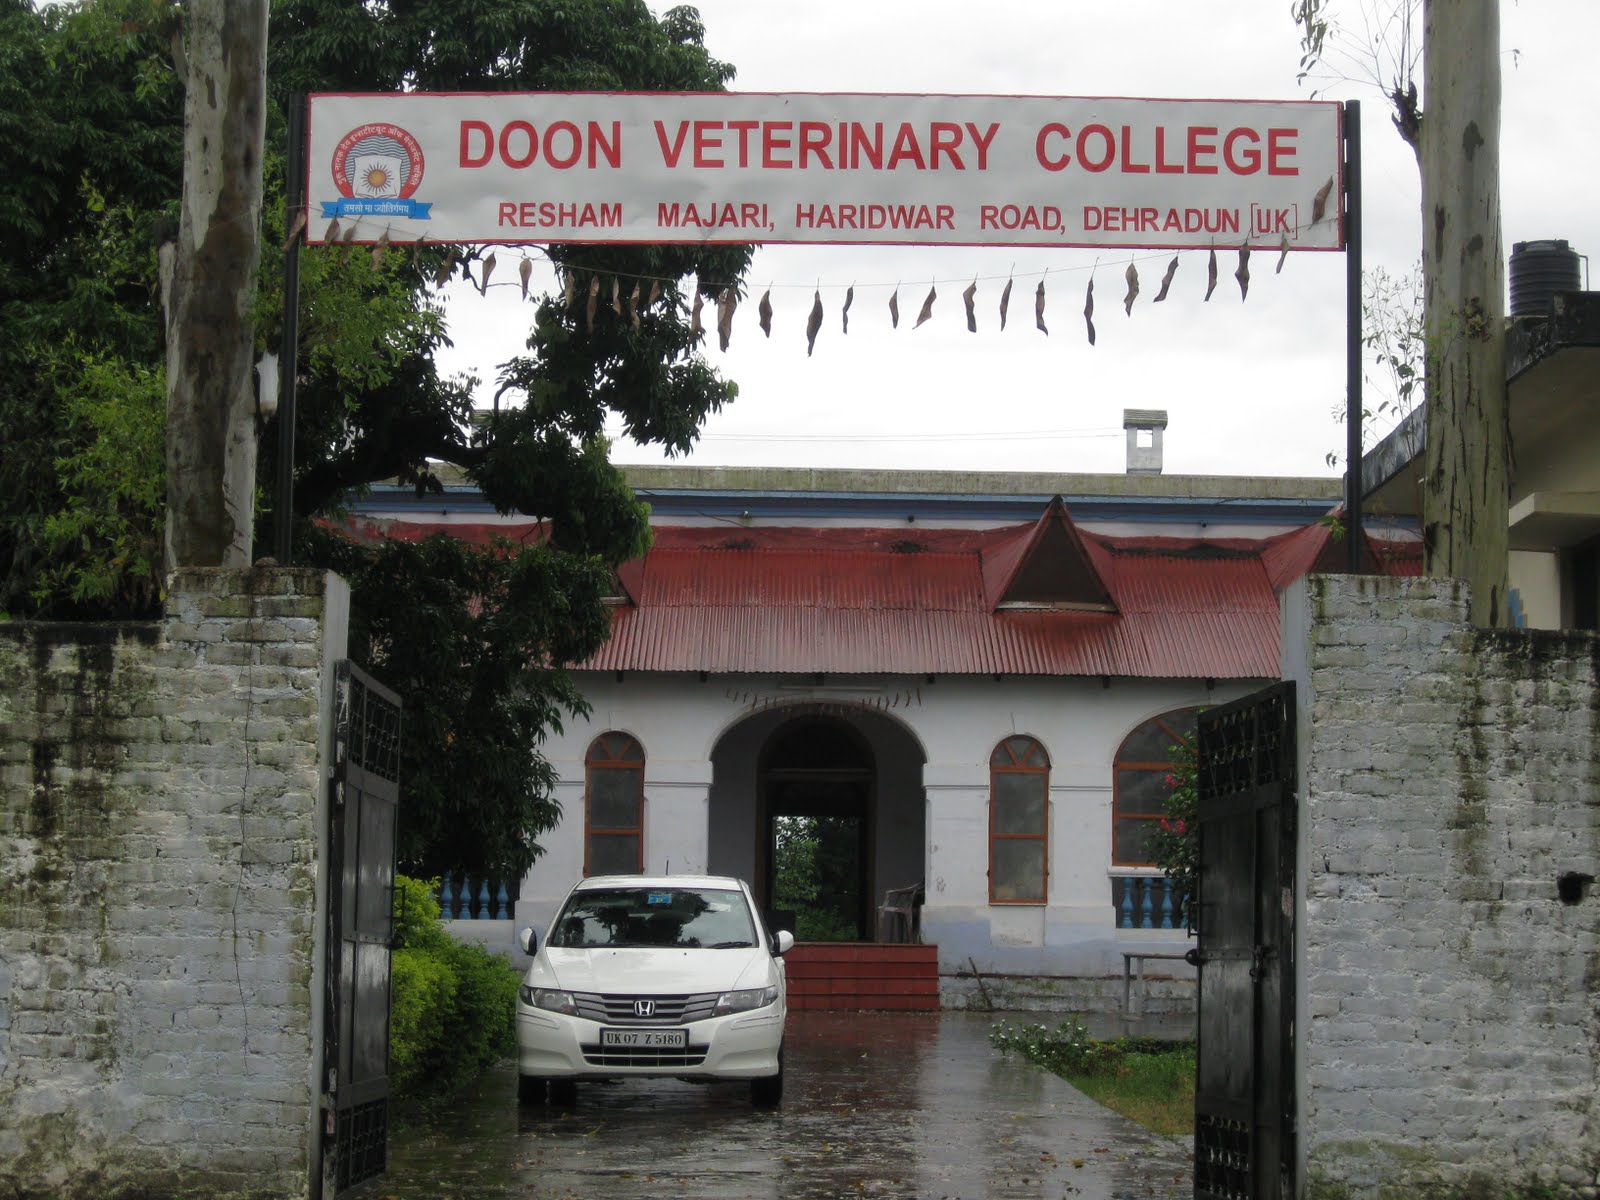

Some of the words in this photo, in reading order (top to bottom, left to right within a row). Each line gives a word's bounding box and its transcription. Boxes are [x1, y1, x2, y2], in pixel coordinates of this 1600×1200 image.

[334, 150, 344, 170] नानक
[340, 139, 352, 150] देव
[459, 119, 621, 169] DOON
[654, 120, 1000, 171] VETERINARY
[1036, 122, 1299, 176] COLLEGE
[343, 202, 363, 213] तमसो
[364, 204, 373, 213] मा
[499, 202, 622, 228] RESHAM
[657, 202, 775, 232] MAJARI,
[795, 203, 955, 230] HARIDWAR
[981, 204, 1066, 235] ROAD,
[1084, 206, 1239, 233] DEHRADUN
